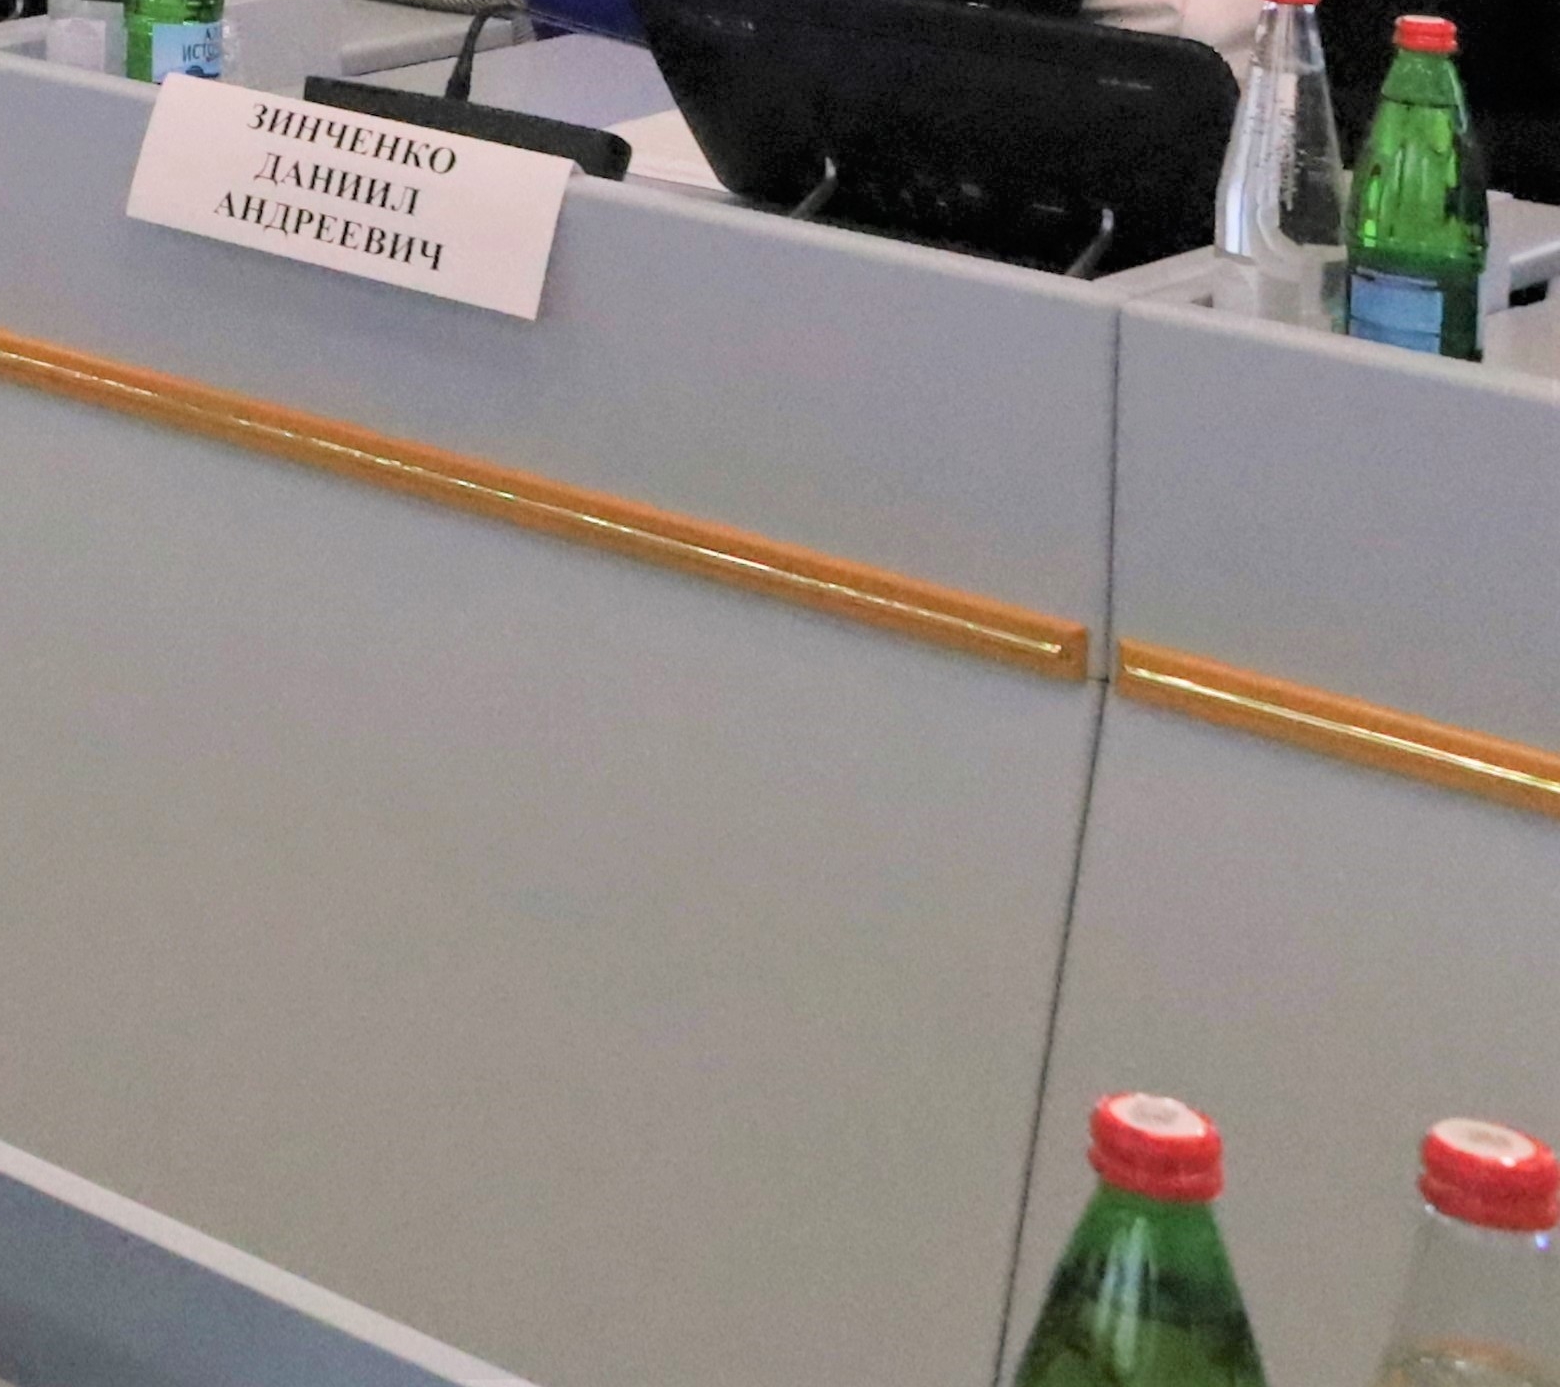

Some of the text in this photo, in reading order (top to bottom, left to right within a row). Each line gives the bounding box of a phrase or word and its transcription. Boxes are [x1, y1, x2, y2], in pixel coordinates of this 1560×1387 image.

[247, 103, 457, 175] ЗИНЧЕНКО
[253, 152, 421, 217] ДАНИИЛ
[213, 190, 446, 272] АНДРЕЕВИЧ
